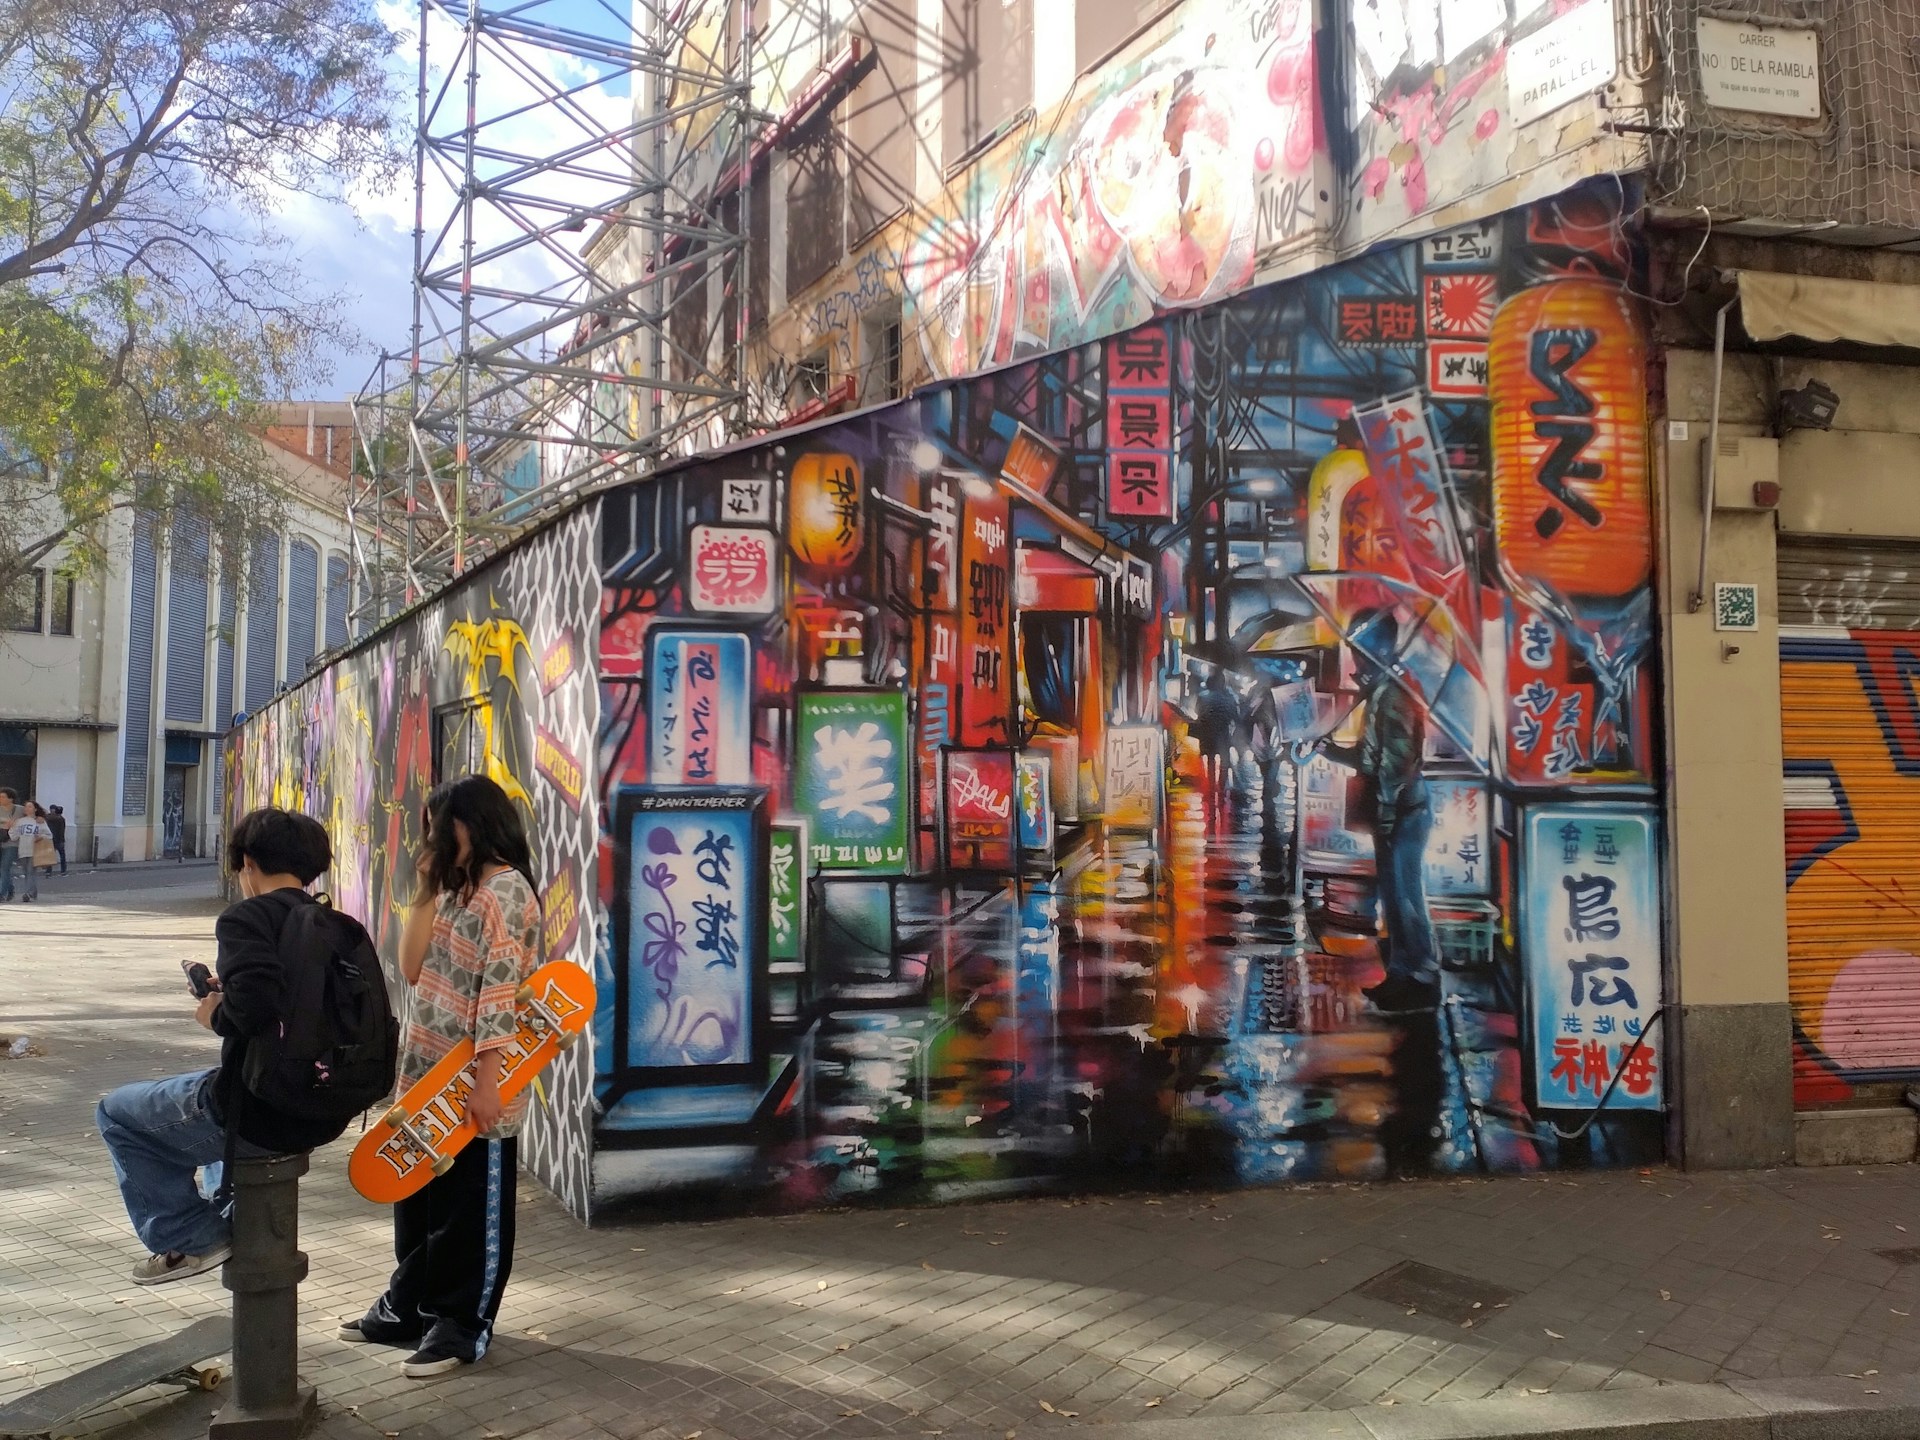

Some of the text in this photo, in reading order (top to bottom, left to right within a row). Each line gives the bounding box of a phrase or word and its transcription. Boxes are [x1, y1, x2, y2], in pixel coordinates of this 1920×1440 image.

[1739, 33, 1776, 48] CARRER
[1731, 56, 1747, 72] DE
[1750, 58, 1765, 74] LA
[1768, 60, 1815, 80] RAMBLA
[1730, 83, 1741, 92] que
[374, 979, 586, 1178] DATWISH
